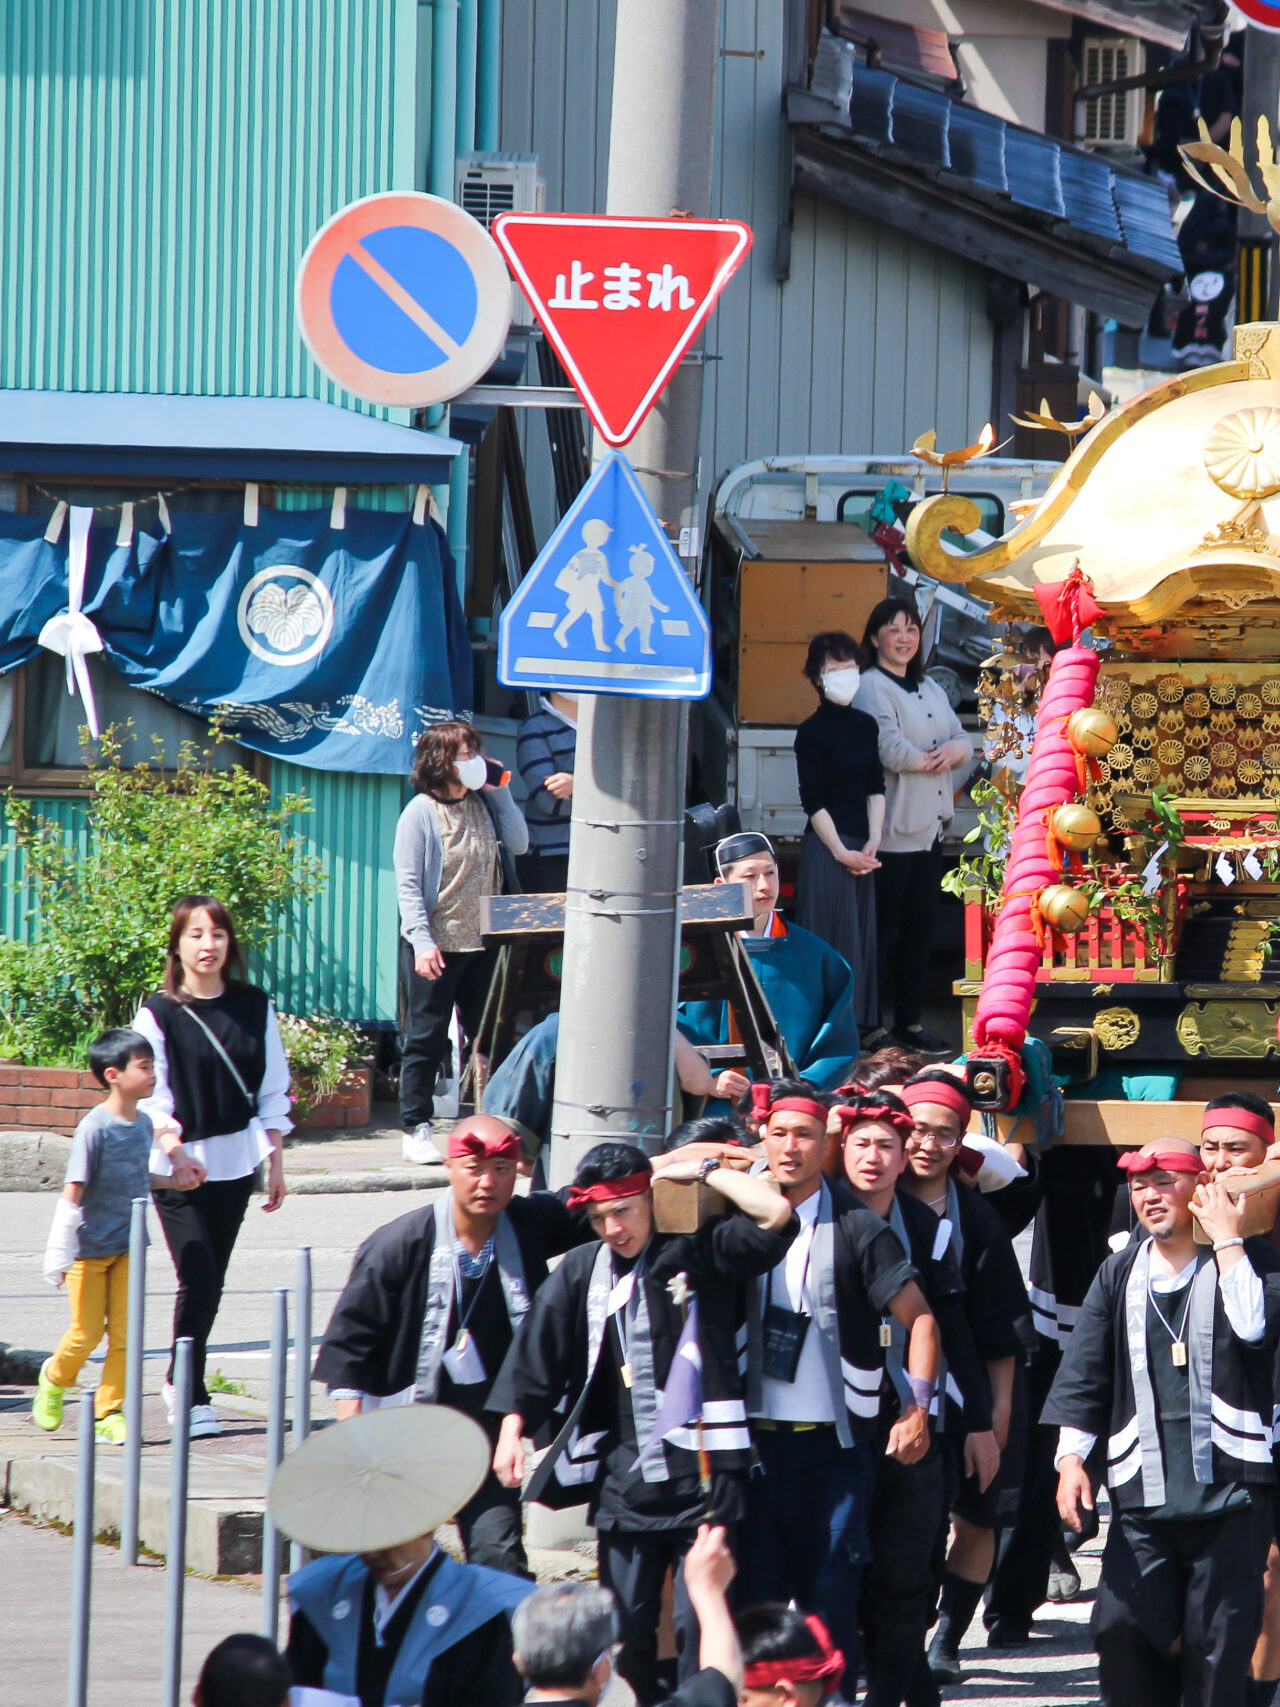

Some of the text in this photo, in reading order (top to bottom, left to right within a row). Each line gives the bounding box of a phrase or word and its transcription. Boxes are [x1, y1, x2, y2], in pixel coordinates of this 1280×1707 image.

[547, 259, 696, 312] 止まれ
[1127, 1268, 1145, 1373] 井波八幡宮
